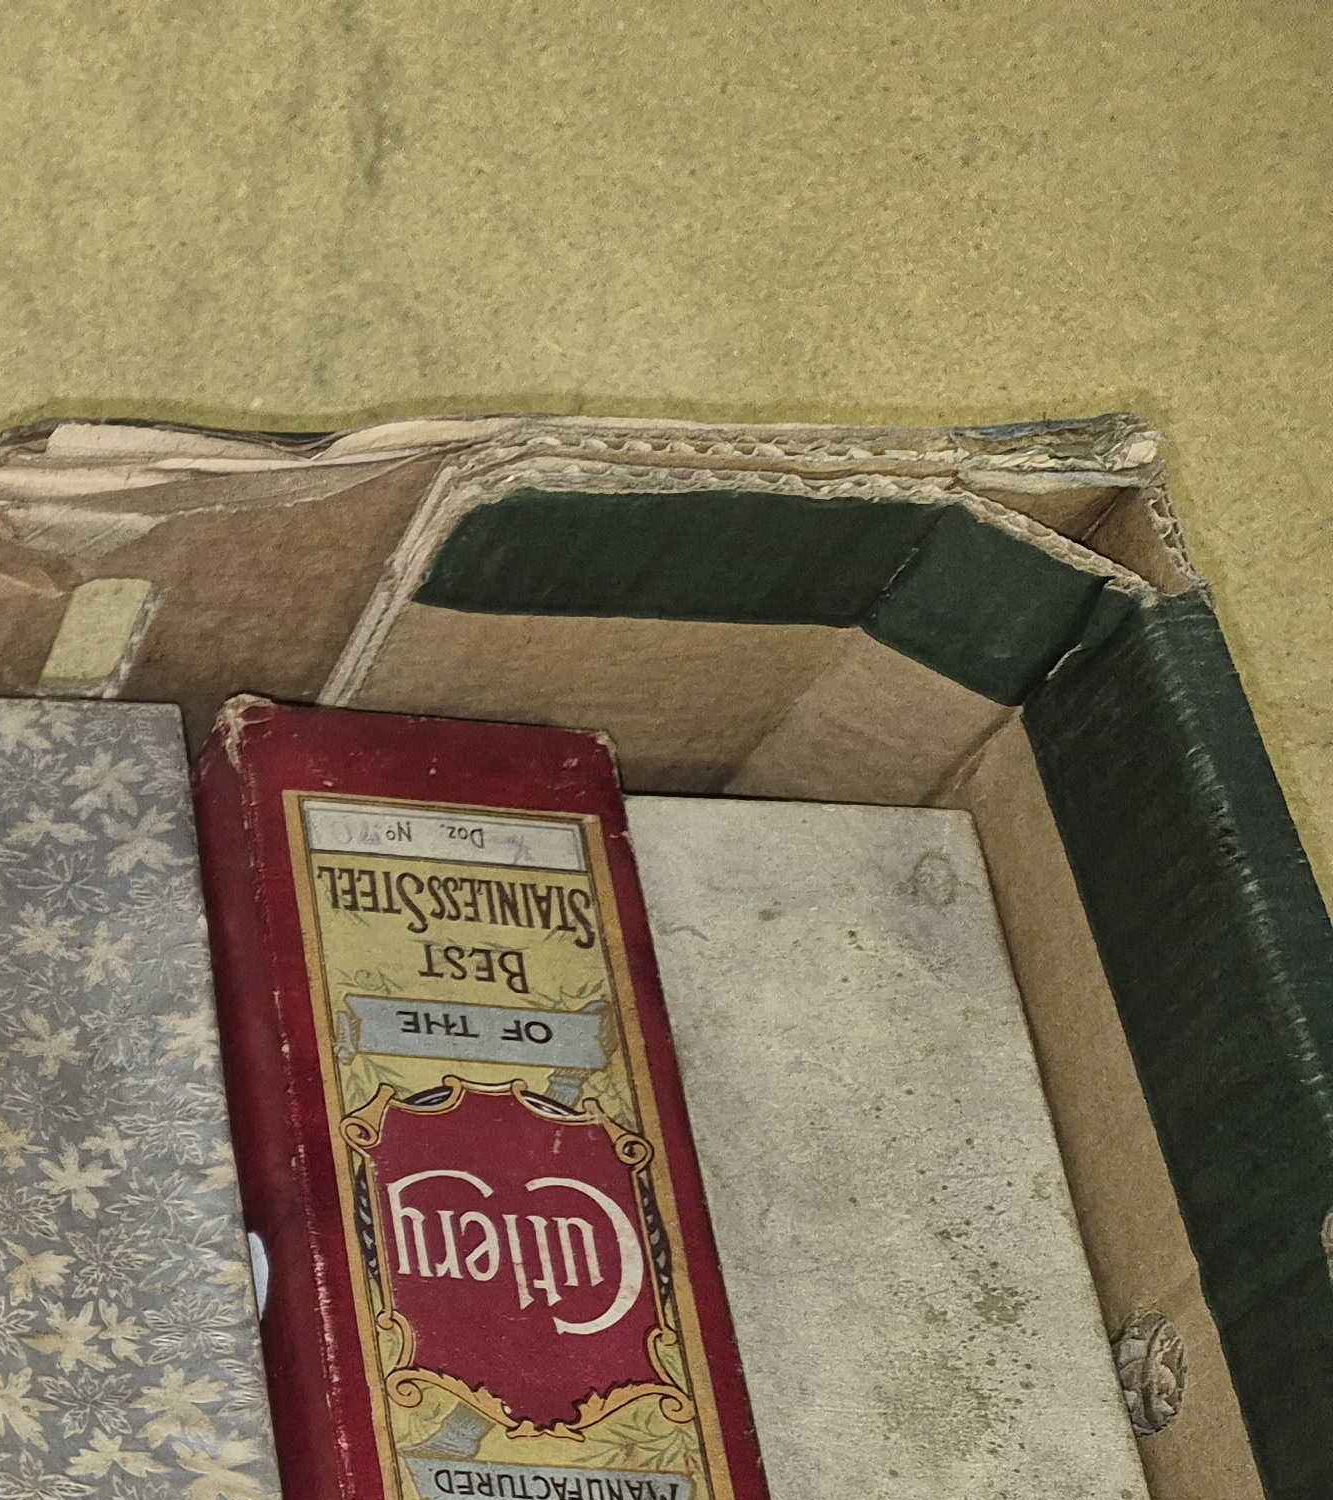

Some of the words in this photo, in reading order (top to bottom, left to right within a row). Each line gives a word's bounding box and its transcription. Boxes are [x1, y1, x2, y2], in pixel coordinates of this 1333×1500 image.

[419, 943, 530, 995] BEST
[396, 1009, 480, 1039] THE
[501, 1019, 554, 1044] OF
[386, 1169, 645, 1336] Cutlery
